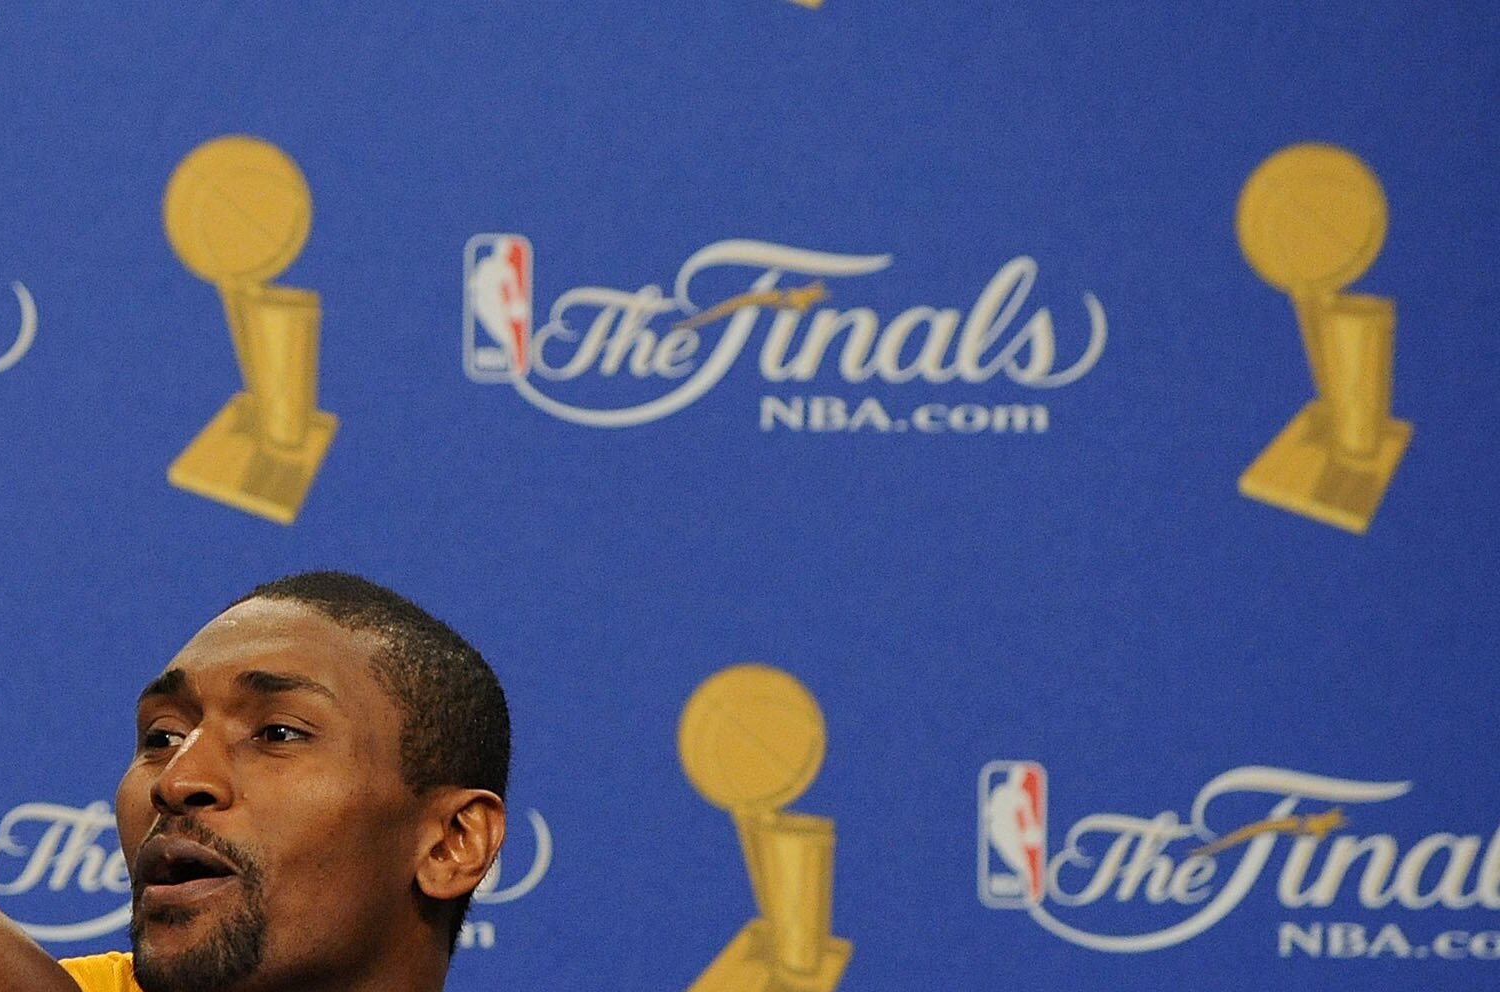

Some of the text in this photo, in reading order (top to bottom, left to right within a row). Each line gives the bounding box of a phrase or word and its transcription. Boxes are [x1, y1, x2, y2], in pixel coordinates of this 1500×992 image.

[532, 238, 1109, 420] The Finals
[758, 395, 1051, 434] NBA.com
[1049, 810, 1218, 905] The
